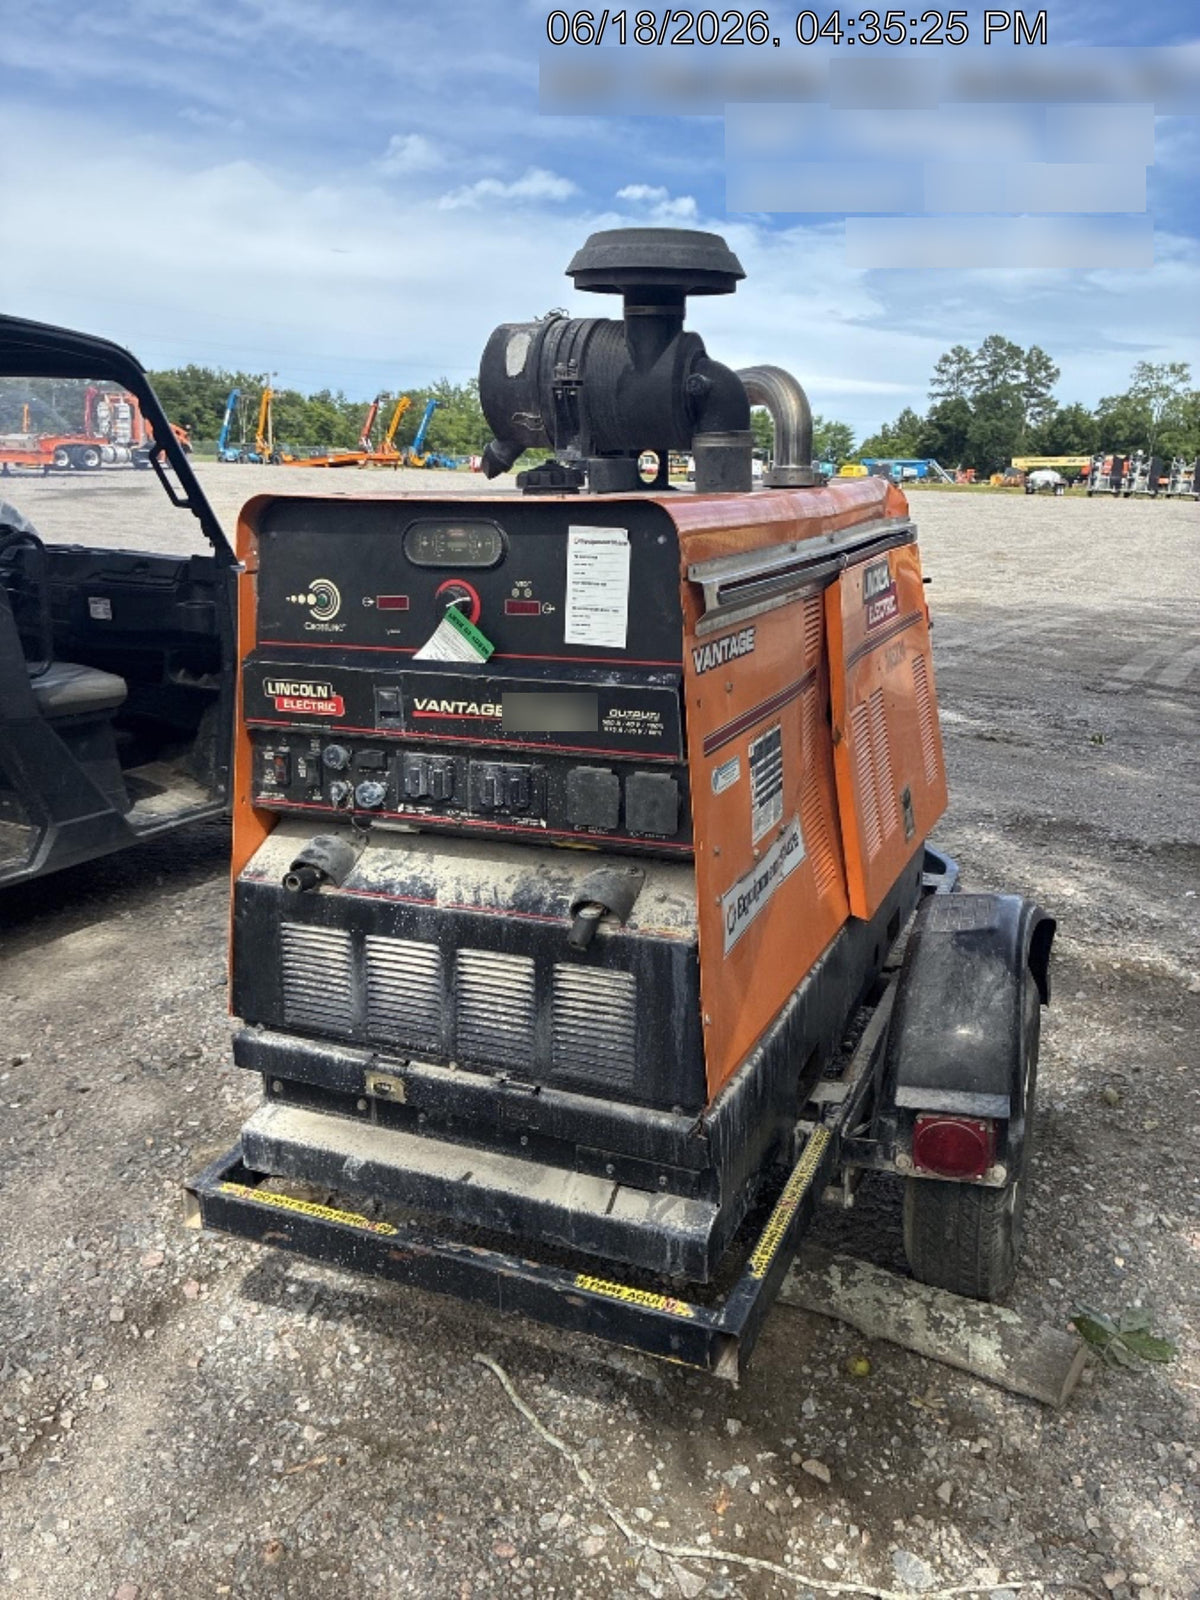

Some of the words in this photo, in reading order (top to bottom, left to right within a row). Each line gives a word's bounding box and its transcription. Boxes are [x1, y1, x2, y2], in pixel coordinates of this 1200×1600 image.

[693, 628, 755, 673] VANTAGE
[267, 681, 328, 698] LINCOLN
[283, 698, 337, 712] ELECTRIC
[413, 698, 503, 716] VANTAGE
[273, 1197, 294, 1207] NOT
[299, 1203, 334, 1217] STAND
[627, 1291, 661, 1305] AQUI
